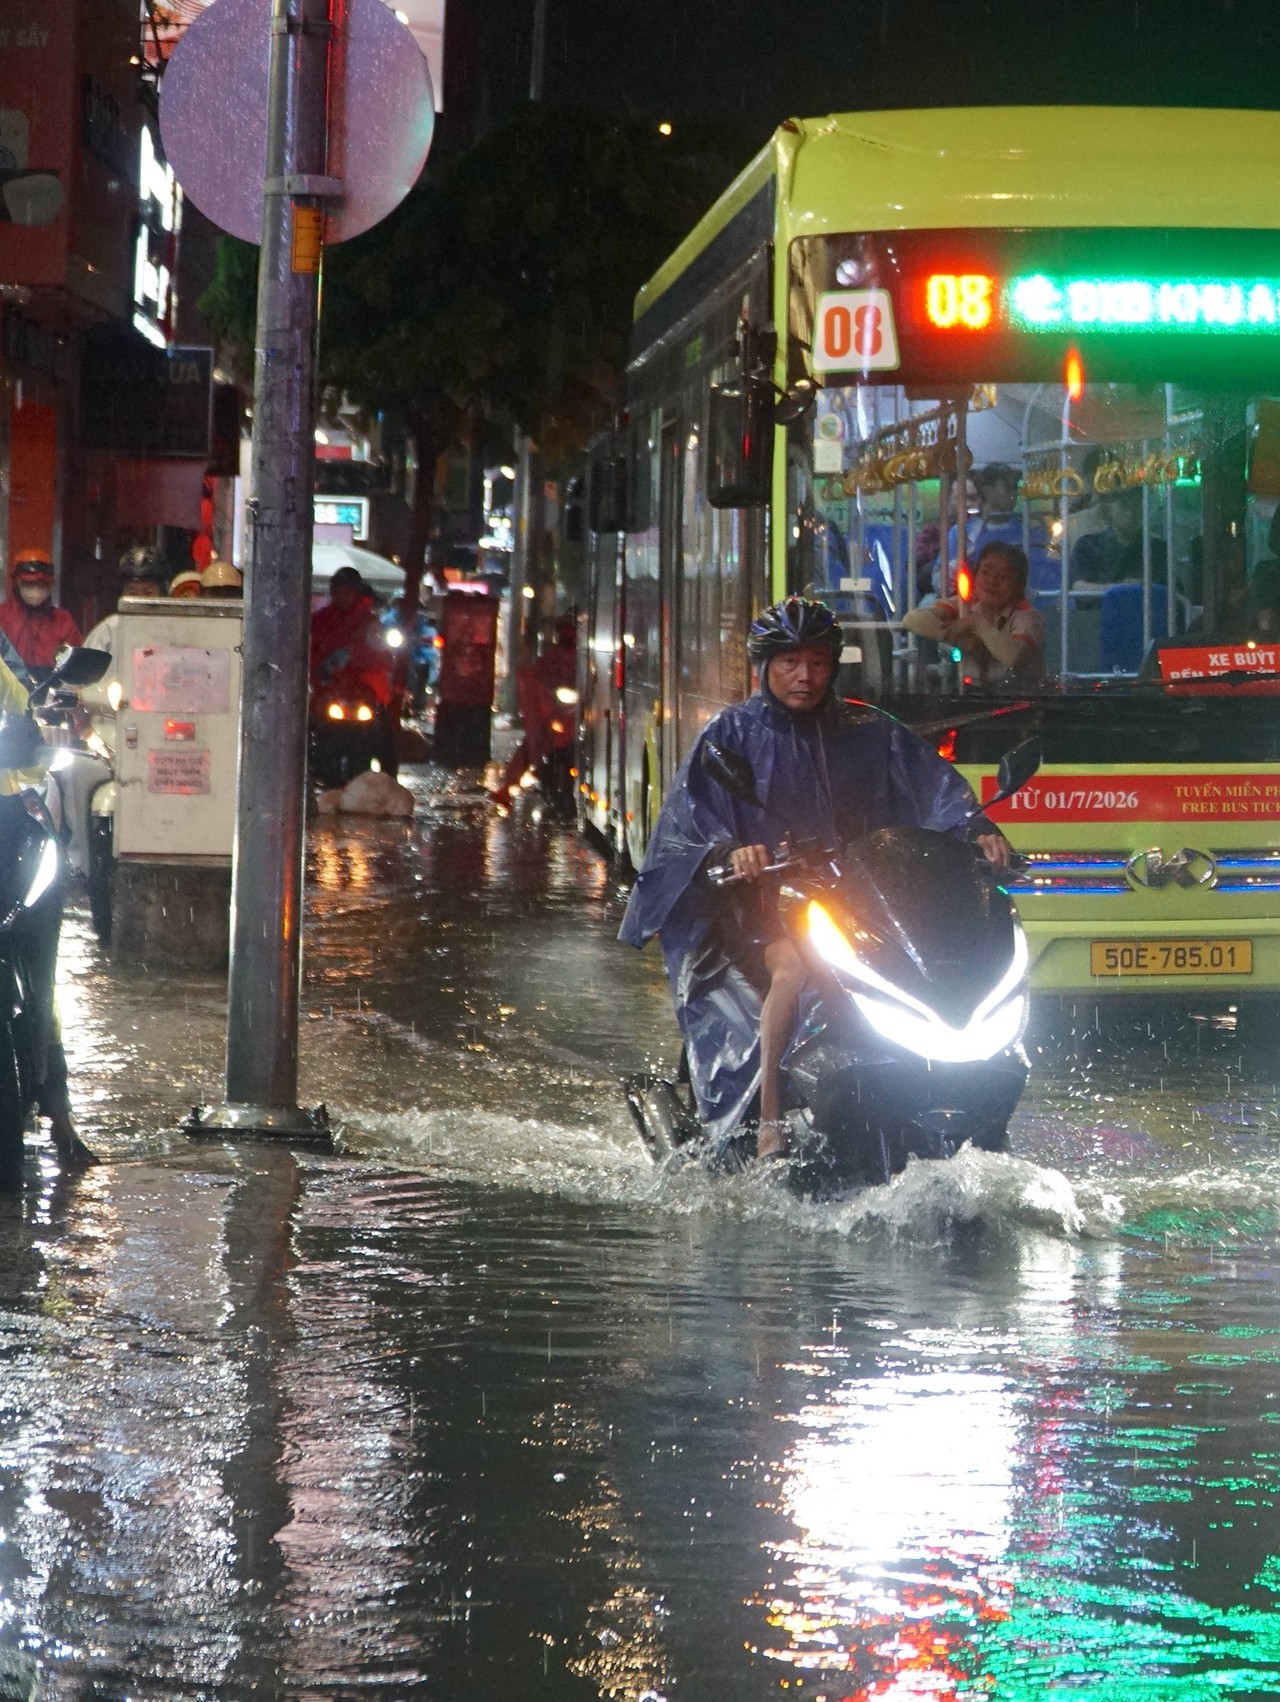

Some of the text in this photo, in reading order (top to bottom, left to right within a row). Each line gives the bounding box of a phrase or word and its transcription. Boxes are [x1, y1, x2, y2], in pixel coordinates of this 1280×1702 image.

[926, 274, 992, 329] 08
[1159, 284, 1243, 323] KHU
[1248, 284, 1275, 323] A
[824, 304, 882, 359] 08
[1208, 653, 1230, 667] XE
[1234, 649, 1275, 666] BUÝT
[1009, 788, 1140, 810] TỪ 01/7/2026
[1174, 782, 1220, 798] TUYẾN
[1225, 780, 1262, 798] MIỄN
[1181, 802, 1218, 814] FREE
[1221, 801, 1249, 814] BUS
[1104, 946, 1237, 969] 50E-785.01
